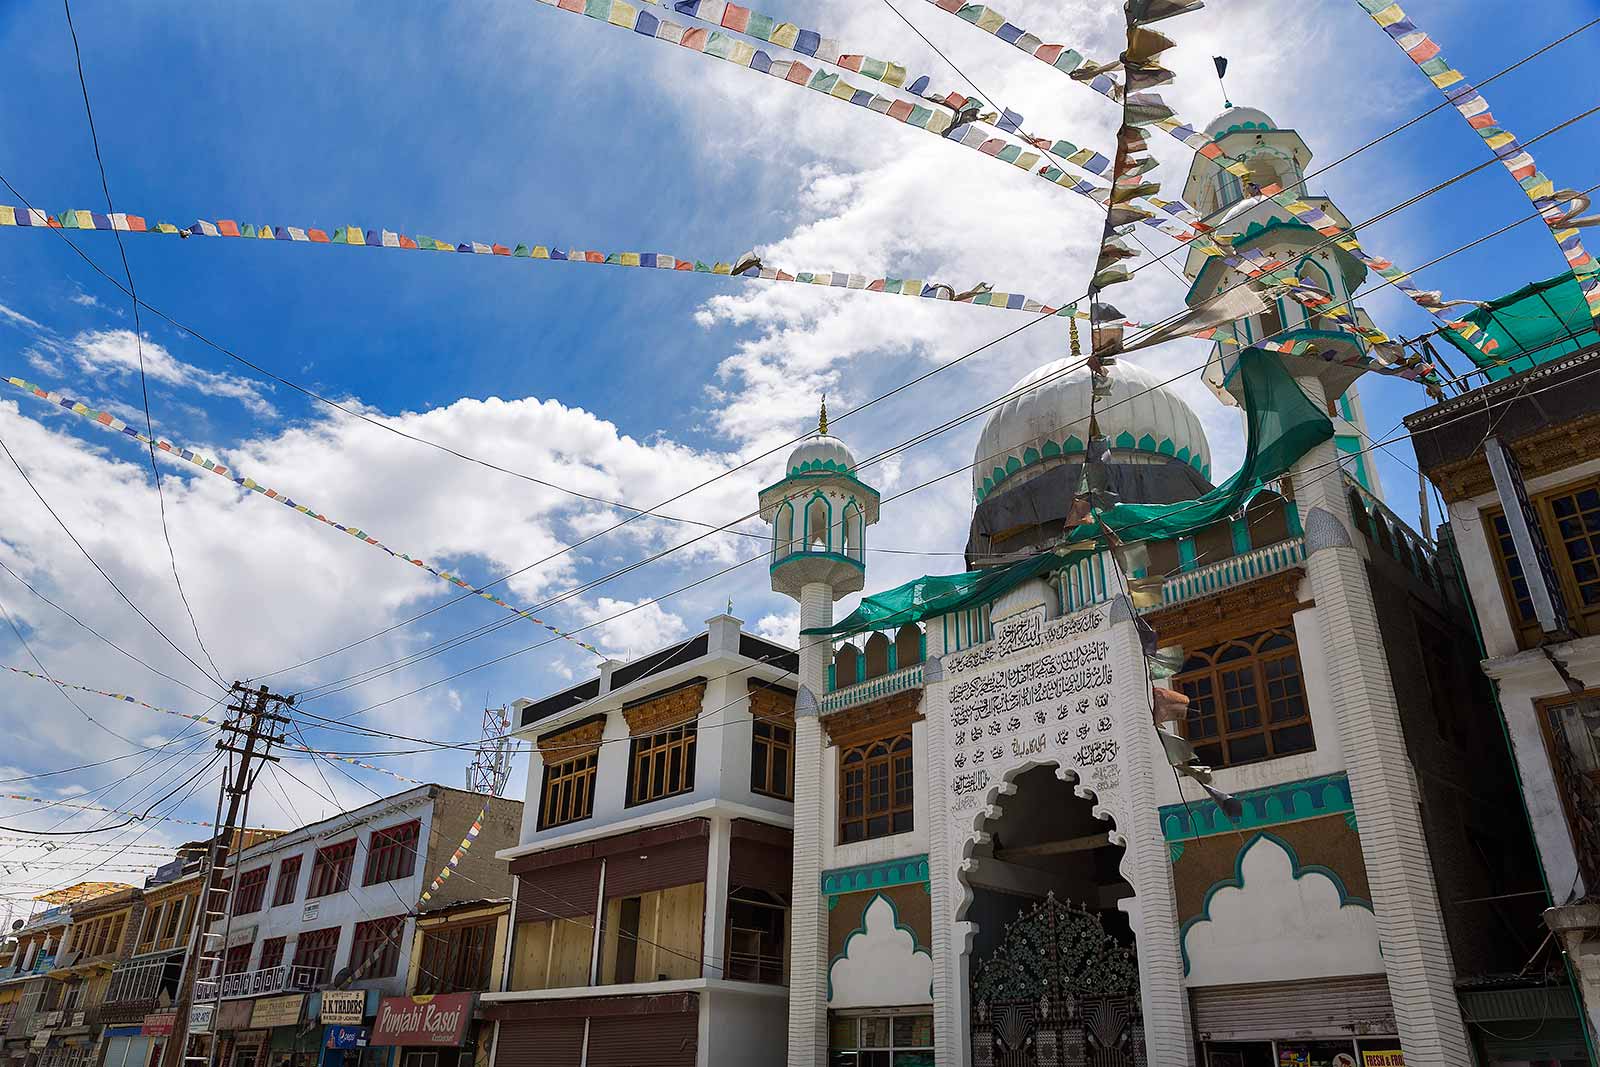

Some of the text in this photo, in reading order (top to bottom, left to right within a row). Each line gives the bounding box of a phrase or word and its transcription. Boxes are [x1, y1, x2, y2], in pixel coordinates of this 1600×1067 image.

[322, 1000, 362, 1013] A K TRADERS
[379, 1005, 423, 1036] Punjabi
[1366, 1054, 1405, 1066] FRESH & FRO
